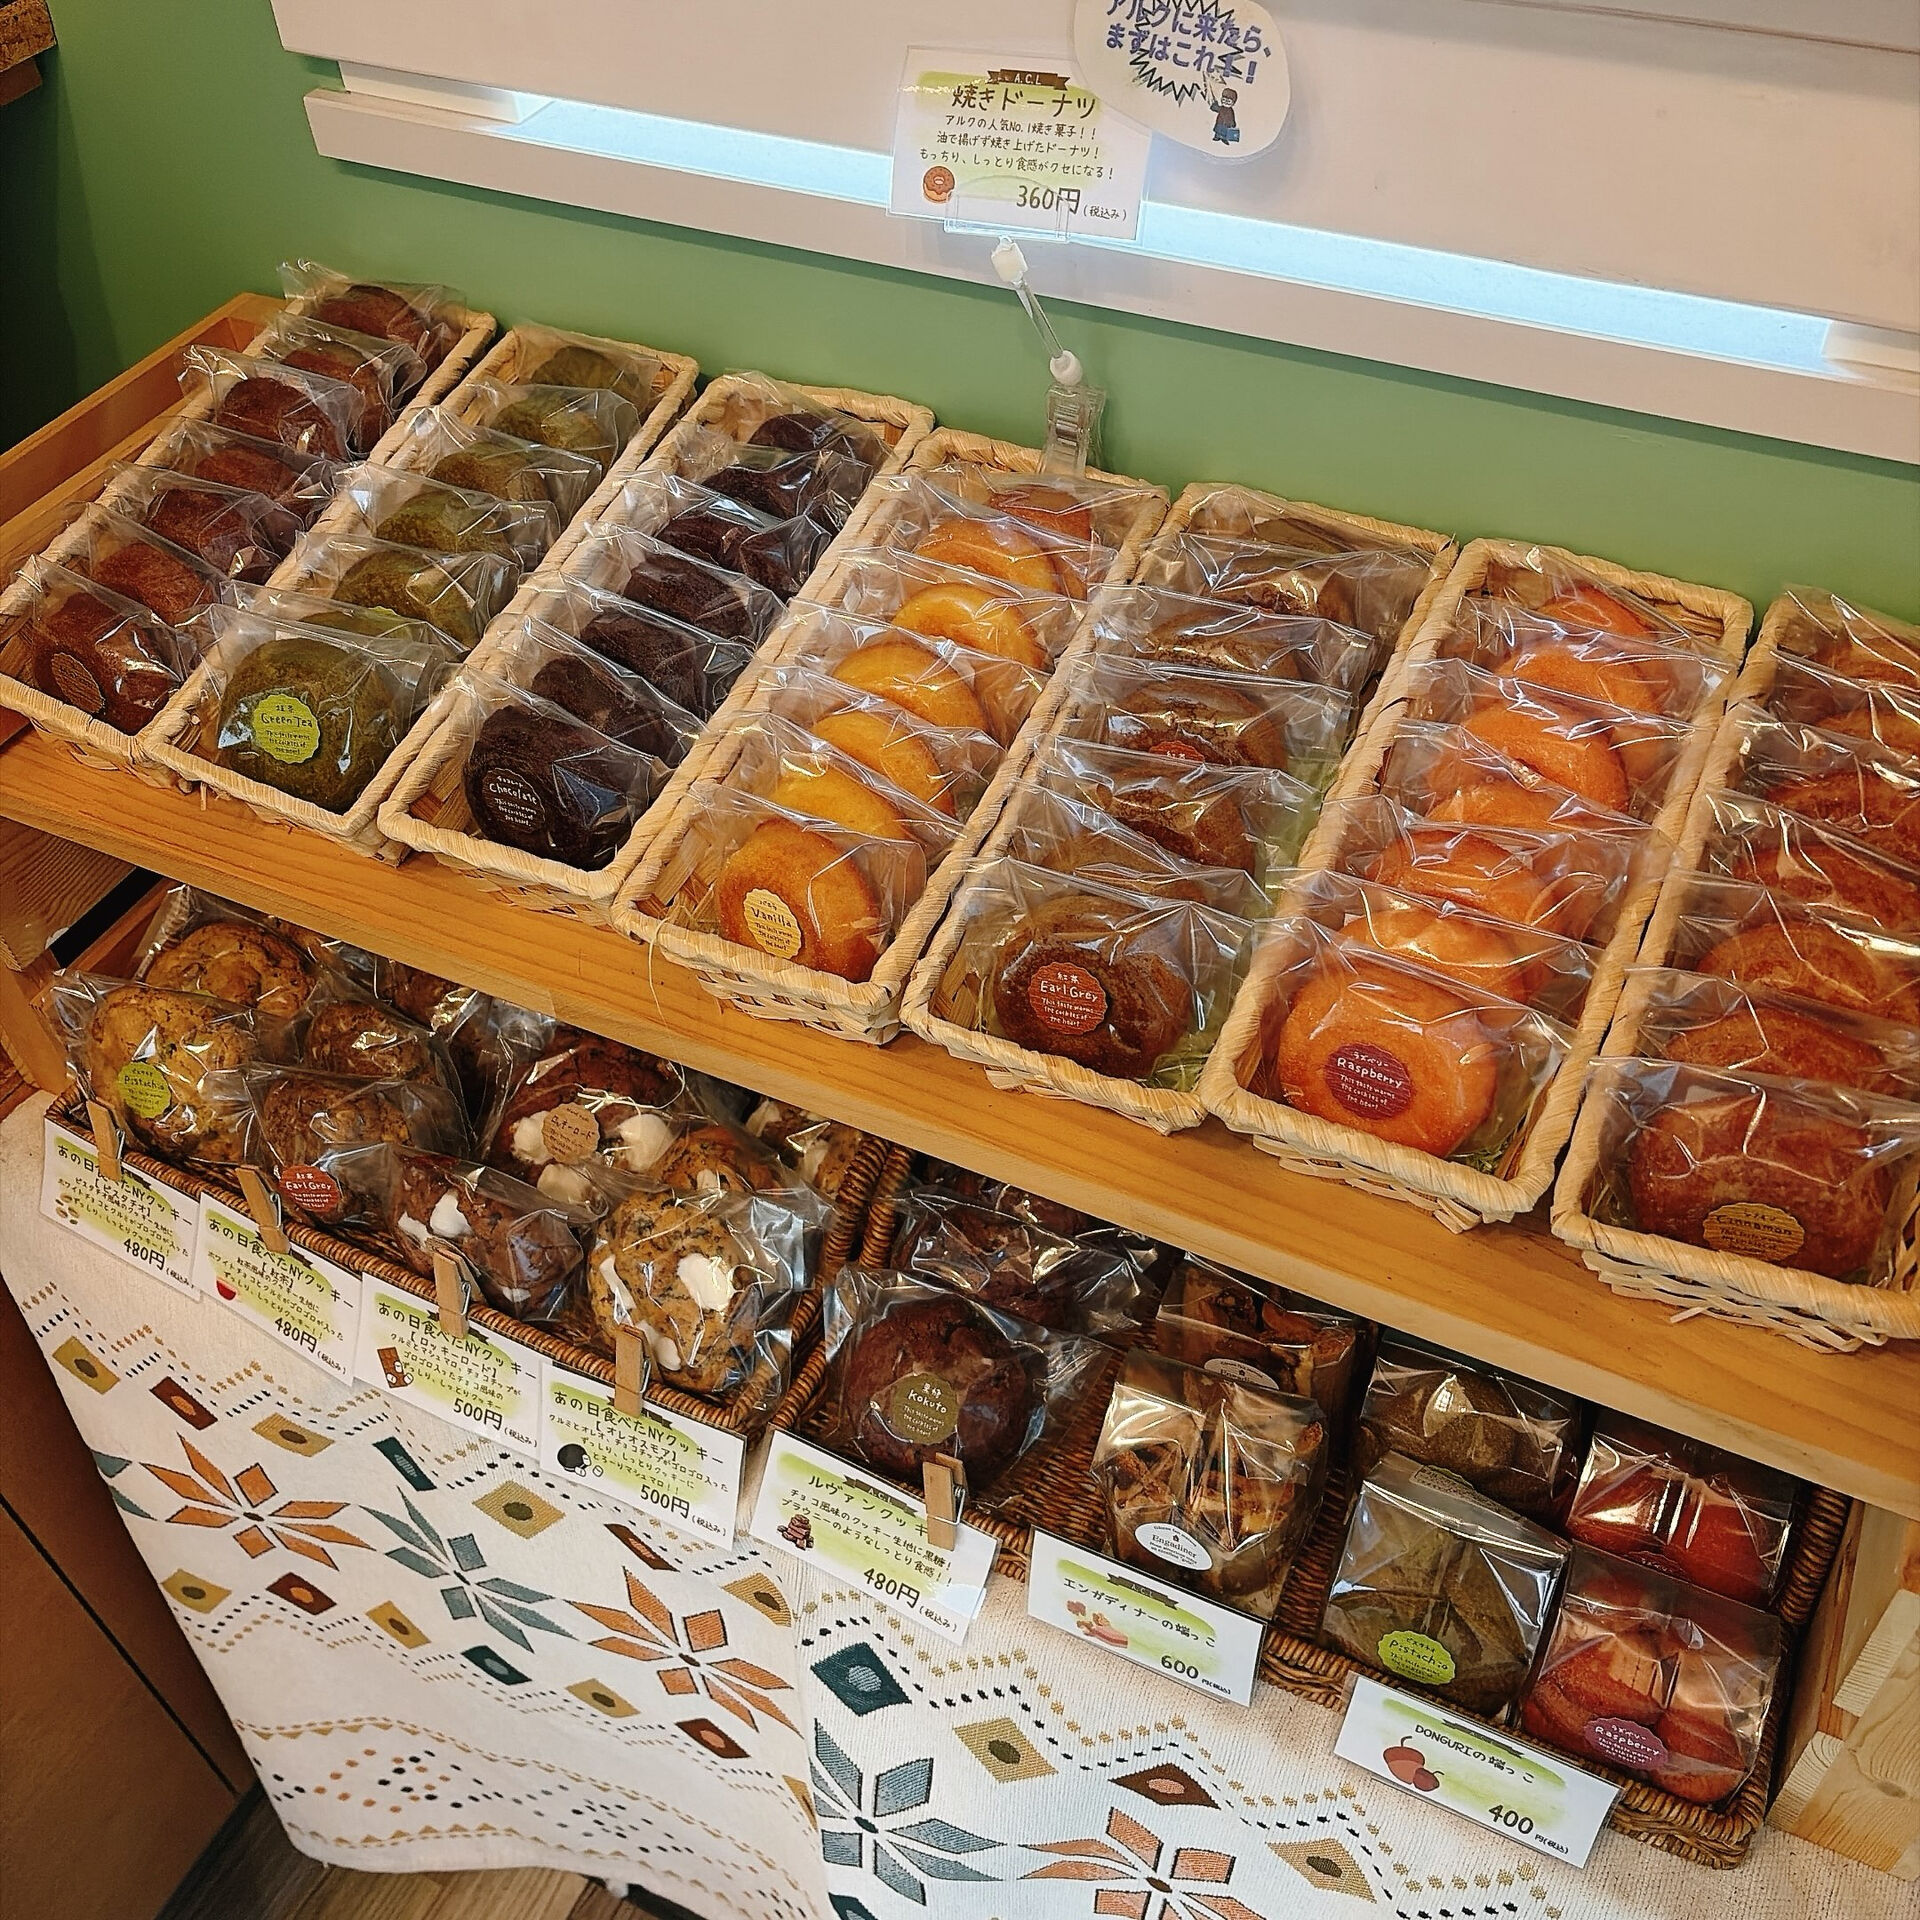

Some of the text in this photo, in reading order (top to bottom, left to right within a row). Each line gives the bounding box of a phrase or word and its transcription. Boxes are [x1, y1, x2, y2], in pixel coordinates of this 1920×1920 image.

[952, 84, 1095, 118] 焼きドーナツ
[937, 131, 1098, 158] 油で揚げず焼き上げたドーナツ！
[920, 148, 1113, 179] もっちり、しっとり食感がクセになる！
[1016, 185, 1080, 214] 360円
[261, 713, 312, 728] Green Tea
[490, 783, 536, 805] Chocolate
[751, 907, 791, 927] Vanilla
[1041, 981, 1097, 1002] Earl Grey
[1337, 1057, 1403, 1088] Raspberry
[58, 1145, 192, 1225] あの日たNYクッキー
[286, 1182, 331, 1190] Earl Grey
[124, 1238, 165, 1270] 480円
[208, 1219, 353, 1308] あの日食べたNYクッキー
[275, 1317, 317, 1353] 480円
[378, 1302, 536, 1379] あの日食べたNYクッキー
[410, 1331, 497, 1378] 【ロッキーロード】
[454, 1399, 502, 1430] 500円
[908, 1389, 947, 1413] Kokuto
[554, 1391, 723, 1464] あの日食べたNYクッキー
[596, 1421, 676, 1462] 【オレオスモア】
[640, 1485, 690, 1519] 500円
[808, 1475, 927, 1537] ルヴァンクッキ
[790, 1488, 951, 1570] チョコ風味のクッキー生地に黒糖！
[1152, 1534, 1196, 1558] Engadiner
[864, 1567, 920, 1609] 480円
[1063, 1577, 1215, 1647] エンガディナーの端っこ
[1161, 1655, 1198, 1679] 600
[1389, 1640, 1448, 1669] Pistachio
[1415, 1724, 1535, 1784] DONGURIの端っこ
[1595, 1726, 1659, 1755] Raspberry
[1489, 1804, 1533, 1835] 400
